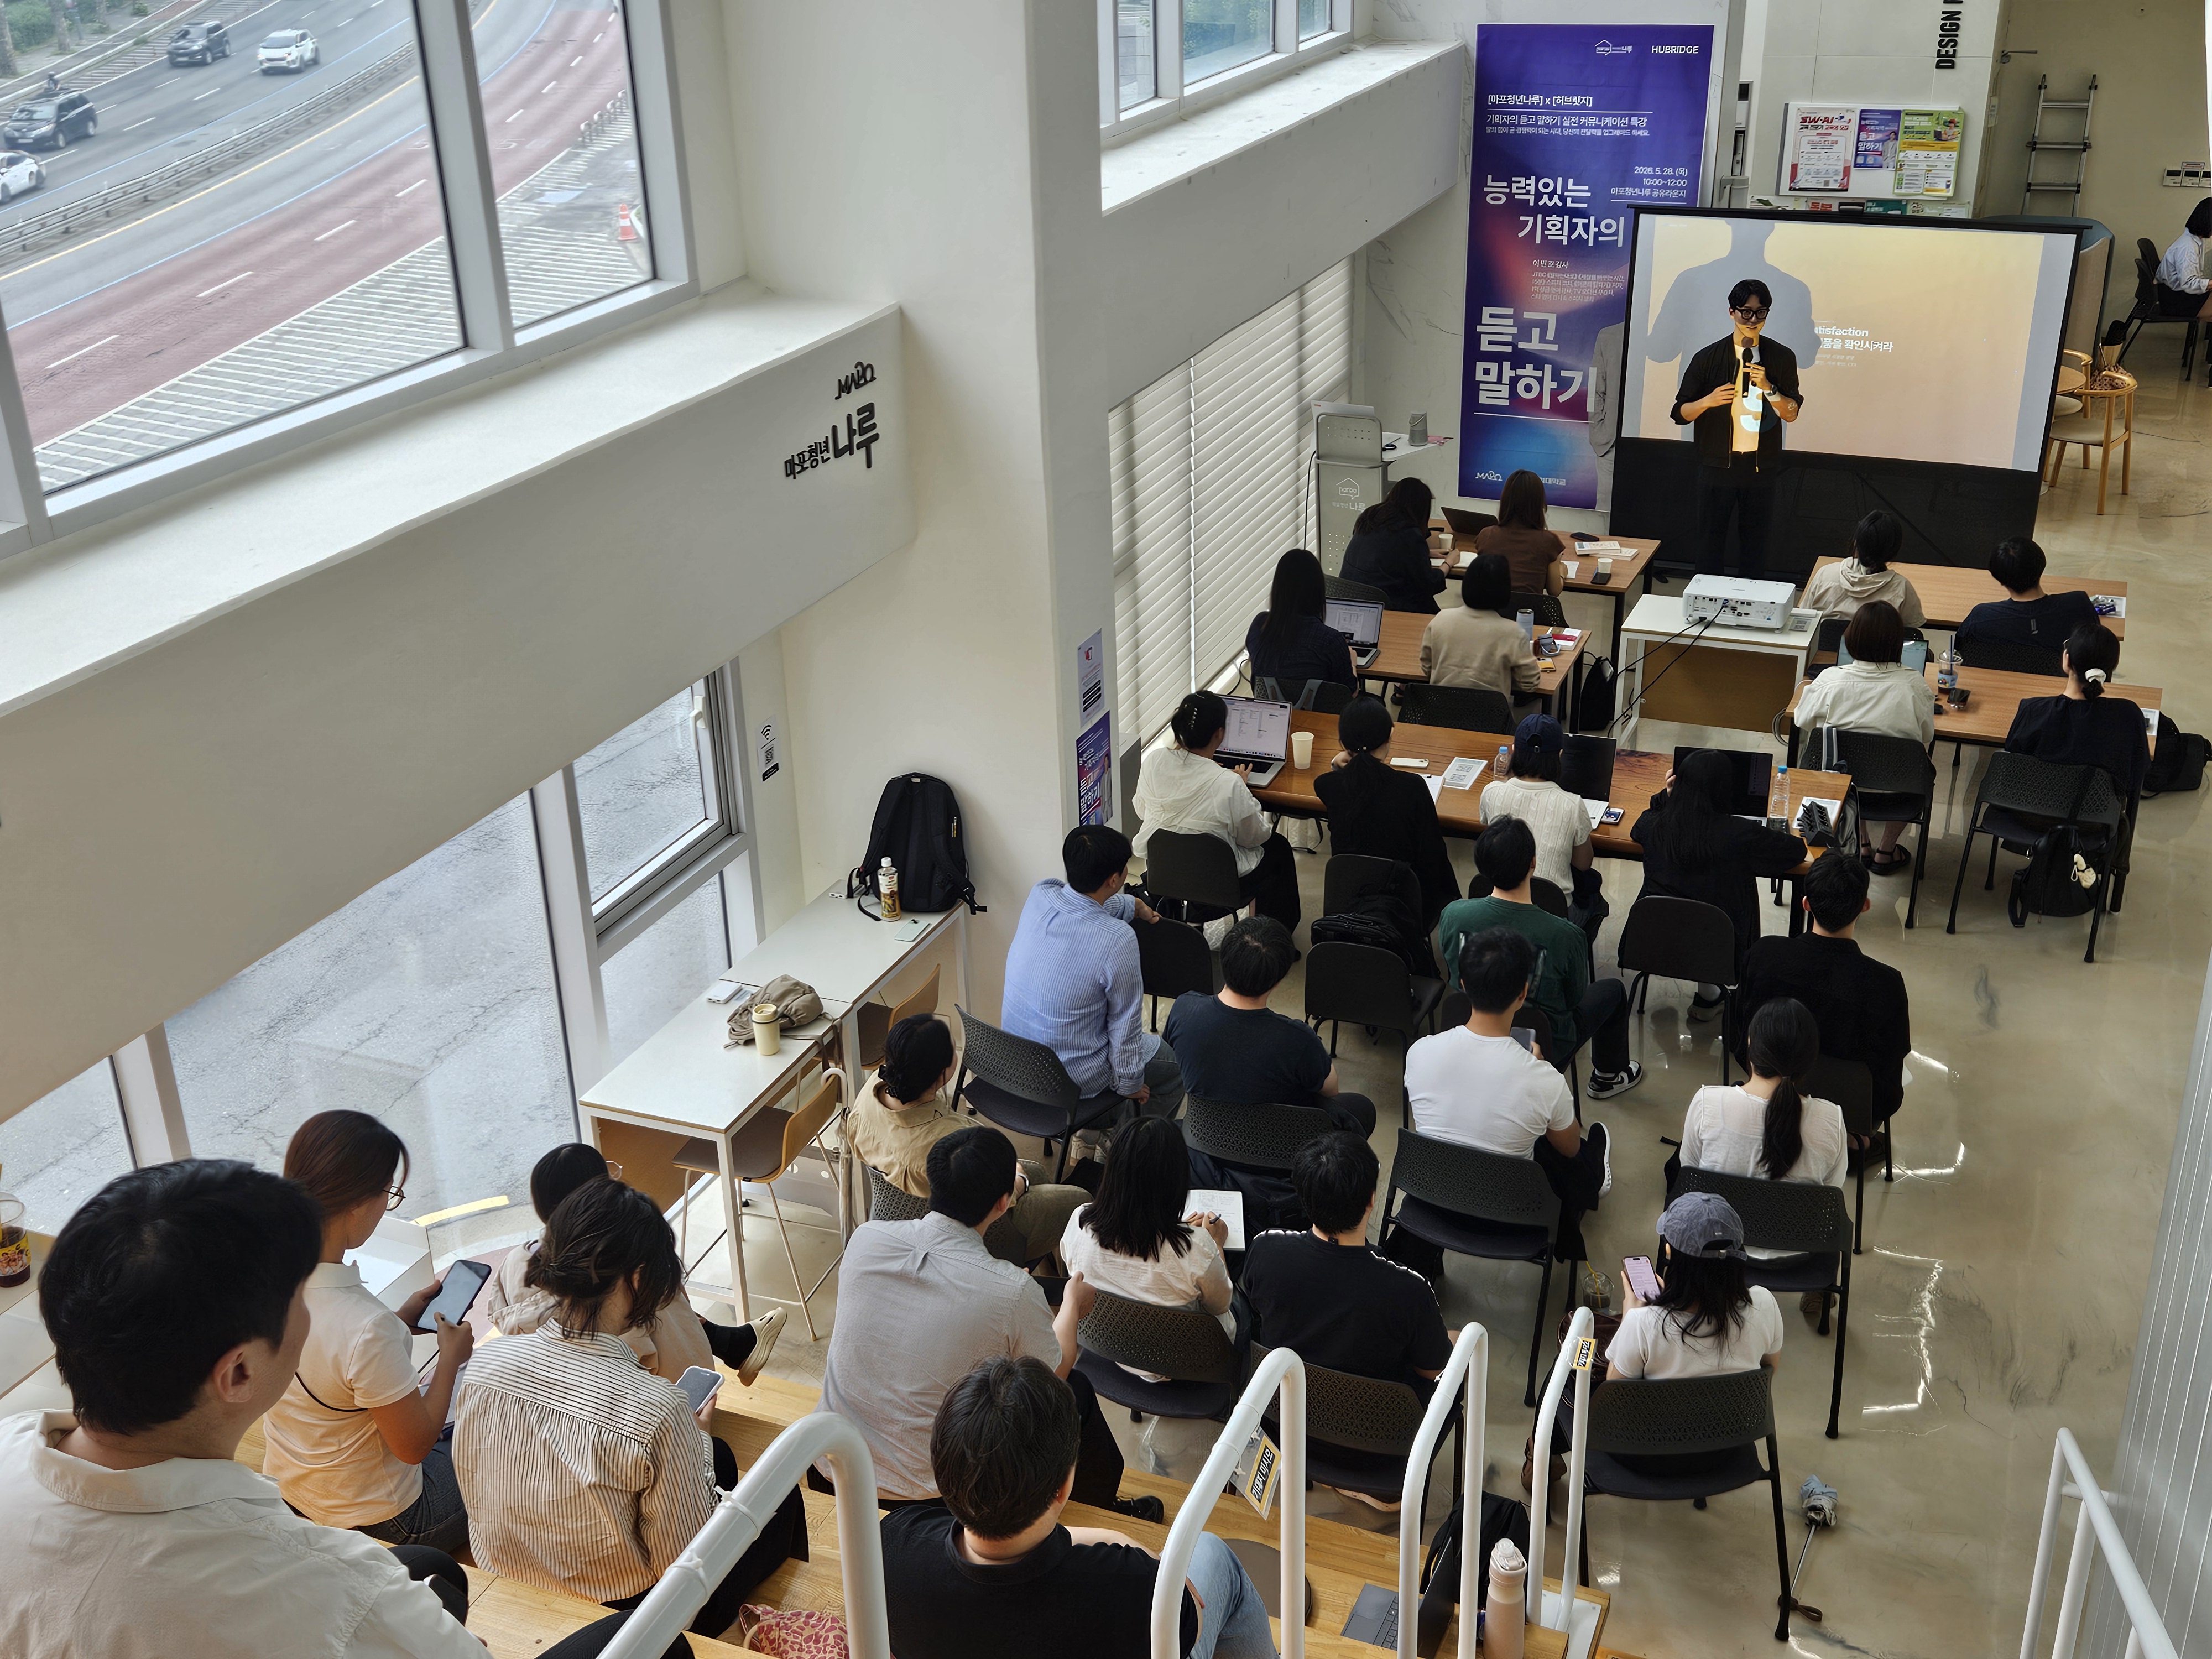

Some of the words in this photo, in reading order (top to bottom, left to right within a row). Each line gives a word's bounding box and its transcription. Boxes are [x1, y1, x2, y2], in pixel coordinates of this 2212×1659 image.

[1936, 11, 1963, 69] DESIGN
[1651, 45, 1699, 54] HUBRIDGE
[1488, 95, 1543, 106] [마포청년나루]
[1553, 96, 1593, 107] [허브릿지]
[1520, 115, 1535, 124] 듣고
[1537, 116, 1560, 126] 말하기
[1563, 116, 1578, 126] 실전
[1580, 117, 1628, 127] 커뮤니케이션
[1630, 117, 1647, 127] 특강
[1643, 178, 1687, 186] 10:00~12:00
[1484, 175, 1591, 207] 능력있는
[1652, 189, 1686, 198] 공유라운지
[1518, 214, 1624, 247] 기획자의
[1477, 306, 1558, 352] 듣고
[1844, 339, 1893, 352] 확인시켜라
[1475, 361, 1597, 413] 말하기
